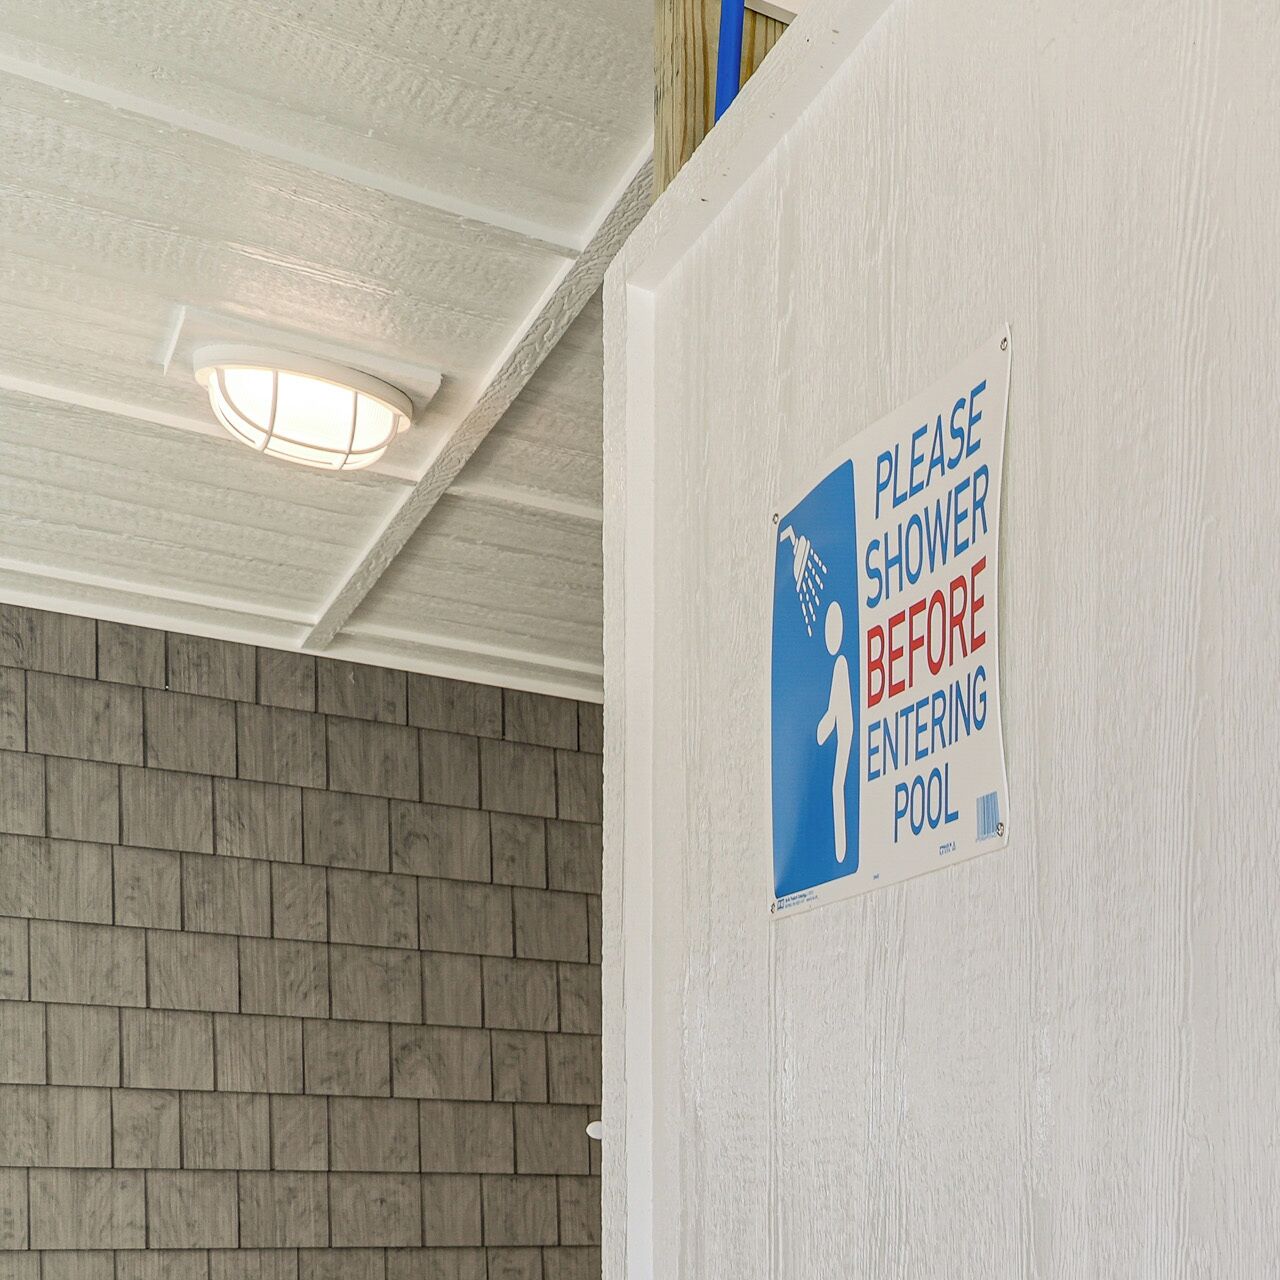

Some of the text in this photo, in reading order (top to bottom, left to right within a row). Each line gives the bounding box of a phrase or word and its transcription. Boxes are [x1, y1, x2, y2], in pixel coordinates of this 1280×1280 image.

[874, 380, 987, 520] PLEASE
[865, 464, 989, 609] SHOWER
[866, 556, 987, 709] BEFORE
[866, 664, 987, 782] ENTERING
[894, 761, 959, 844] POOL
